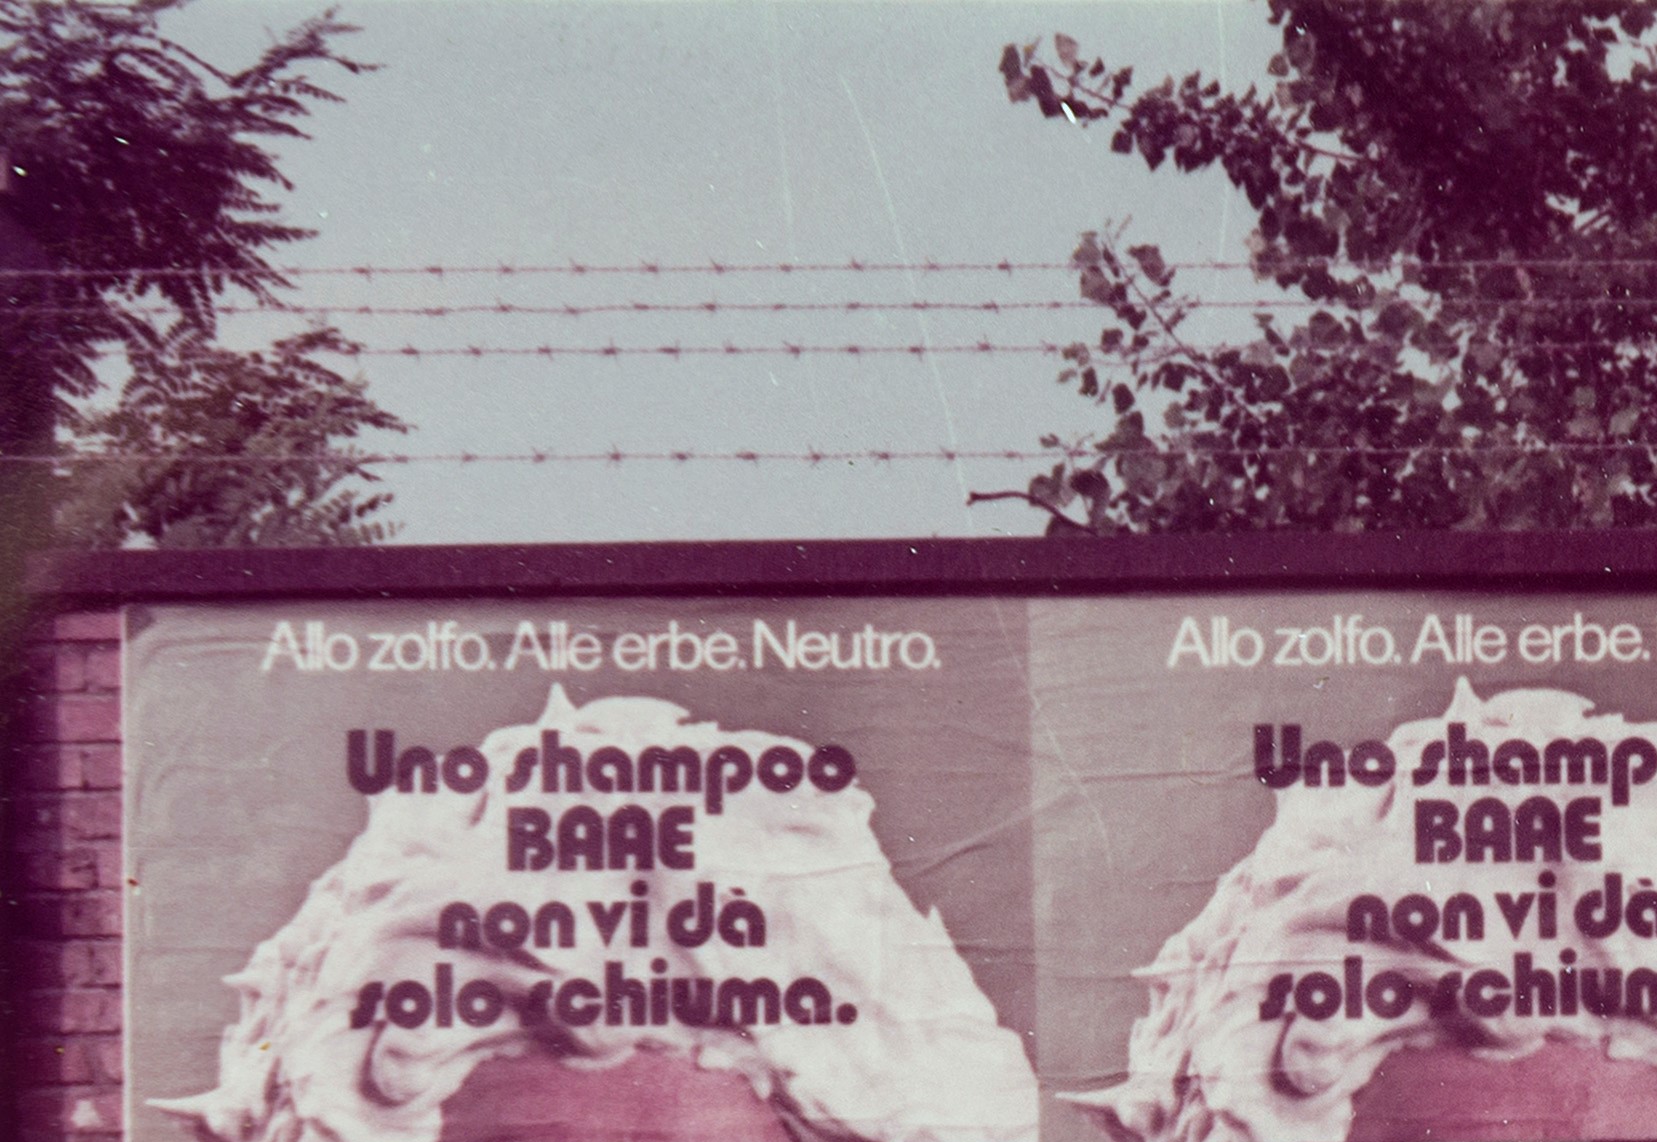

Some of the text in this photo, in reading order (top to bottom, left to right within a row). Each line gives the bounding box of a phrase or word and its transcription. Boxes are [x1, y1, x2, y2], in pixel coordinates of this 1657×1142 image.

[261, 620, 942, 672] Allo zolfo. Alle erbe. Neutro.
[1167, 616, 1265, 668] Allo
[1273, 615, 1403, 666] zolfo.
[1411, 614, 1508, 664] Alle
[1518, 614, 1652, 663] erbe.
[346, 729, 858, 815] Uno shampoo
[1253, 724, 1396, 790] Uno
[507, 806, 695, 872] BAAE
[1414, 798, 1604, 864] BAAE
[437, 880, 766, 950] non vi dà
[1346, 890, 1484, 942] non
[1495, 871, 1557, 941] vi
[350, 958, 860, 1031] solo schiuma.
[1259, 956, 1414, 1022] solo
